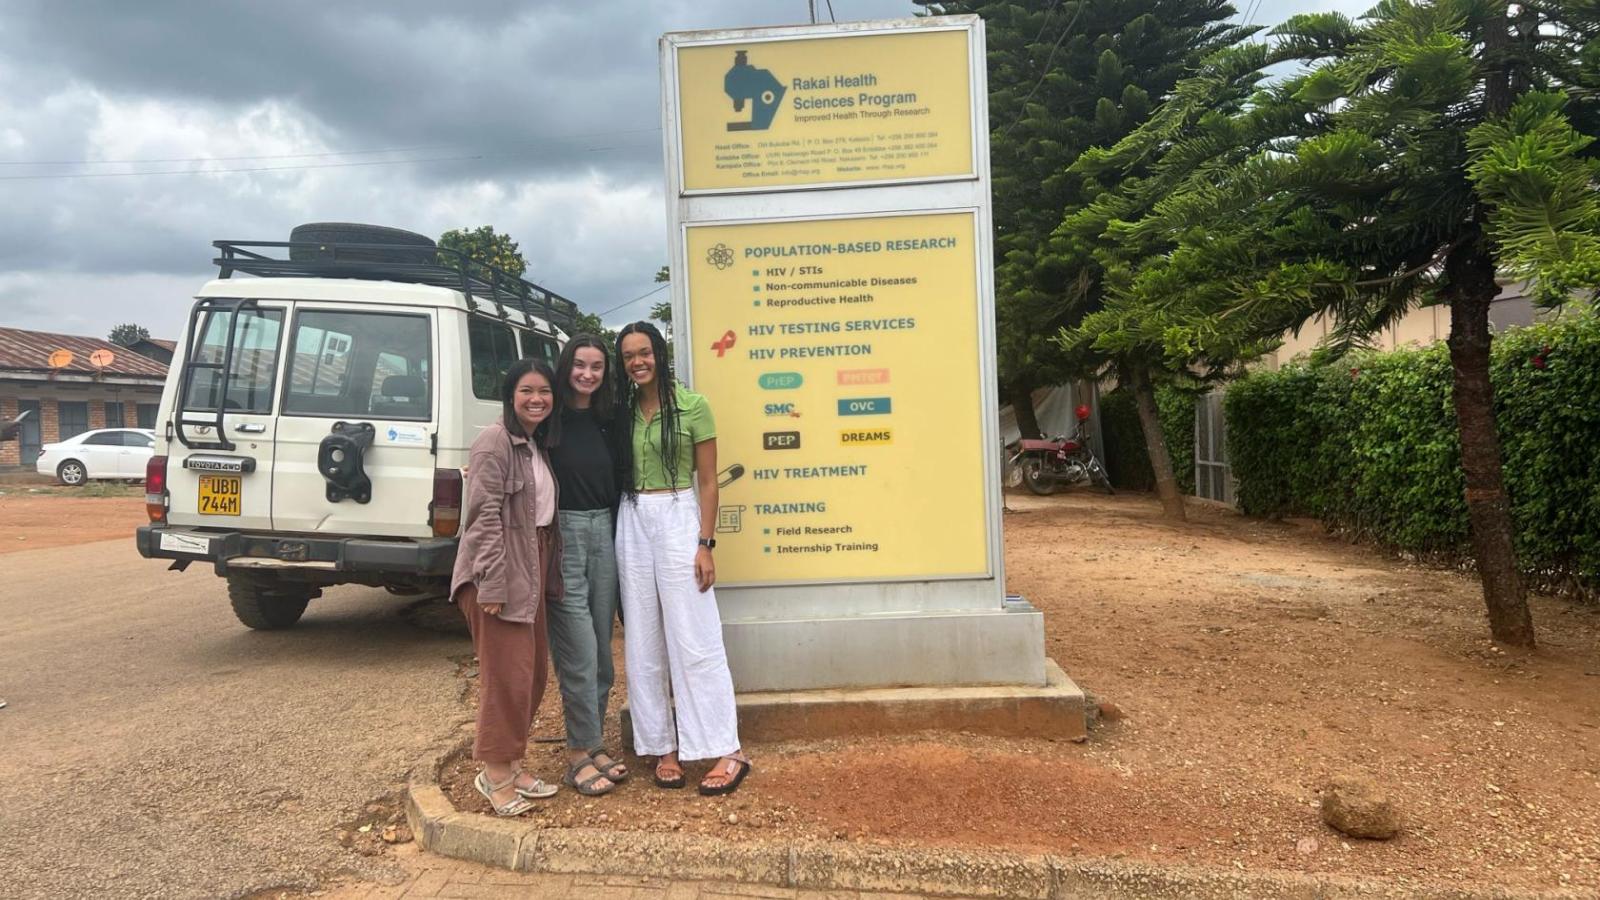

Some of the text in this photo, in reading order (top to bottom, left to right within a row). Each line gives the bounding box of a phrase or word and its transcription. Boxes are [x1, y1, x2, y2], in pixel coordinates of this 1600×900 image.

[793, 73, 878, 91] Rakai Health
[793, 92, 917, 110] Sciences Program
[794, 107, 931, 123] Improved Health Through Research
[744, 237, 956, 258] POPULATION-BASED RESEARCH
[766, 266, 823, 277] HIV / STIs
[766, 276, 918, 292] Non-communicable Diseases
[766, 294, 874, 308] Reproductive Health
[748, 318, 916, 336] HIV TESTING SERVICES
[749, 344, 872, 360] HIV PREVENTION
[764, 403, 795, 415] SMC
[850, 401, 875, 412] OVC
[768, 435, 796, 446] PEP
[842, 432, 891, 442] DREAMS
[189, 461, 221, 470] TOYOTA
[753, 465, 868, 480] HIV TREATMENT
[211, 479, 239, 495] UBD
[202, 496, 237, 512] 744M
[754, 502, 826, 515] TRAINING
[776, 525, 853, 536] Field Research
[776, 542, 879, 555] Internship Training
